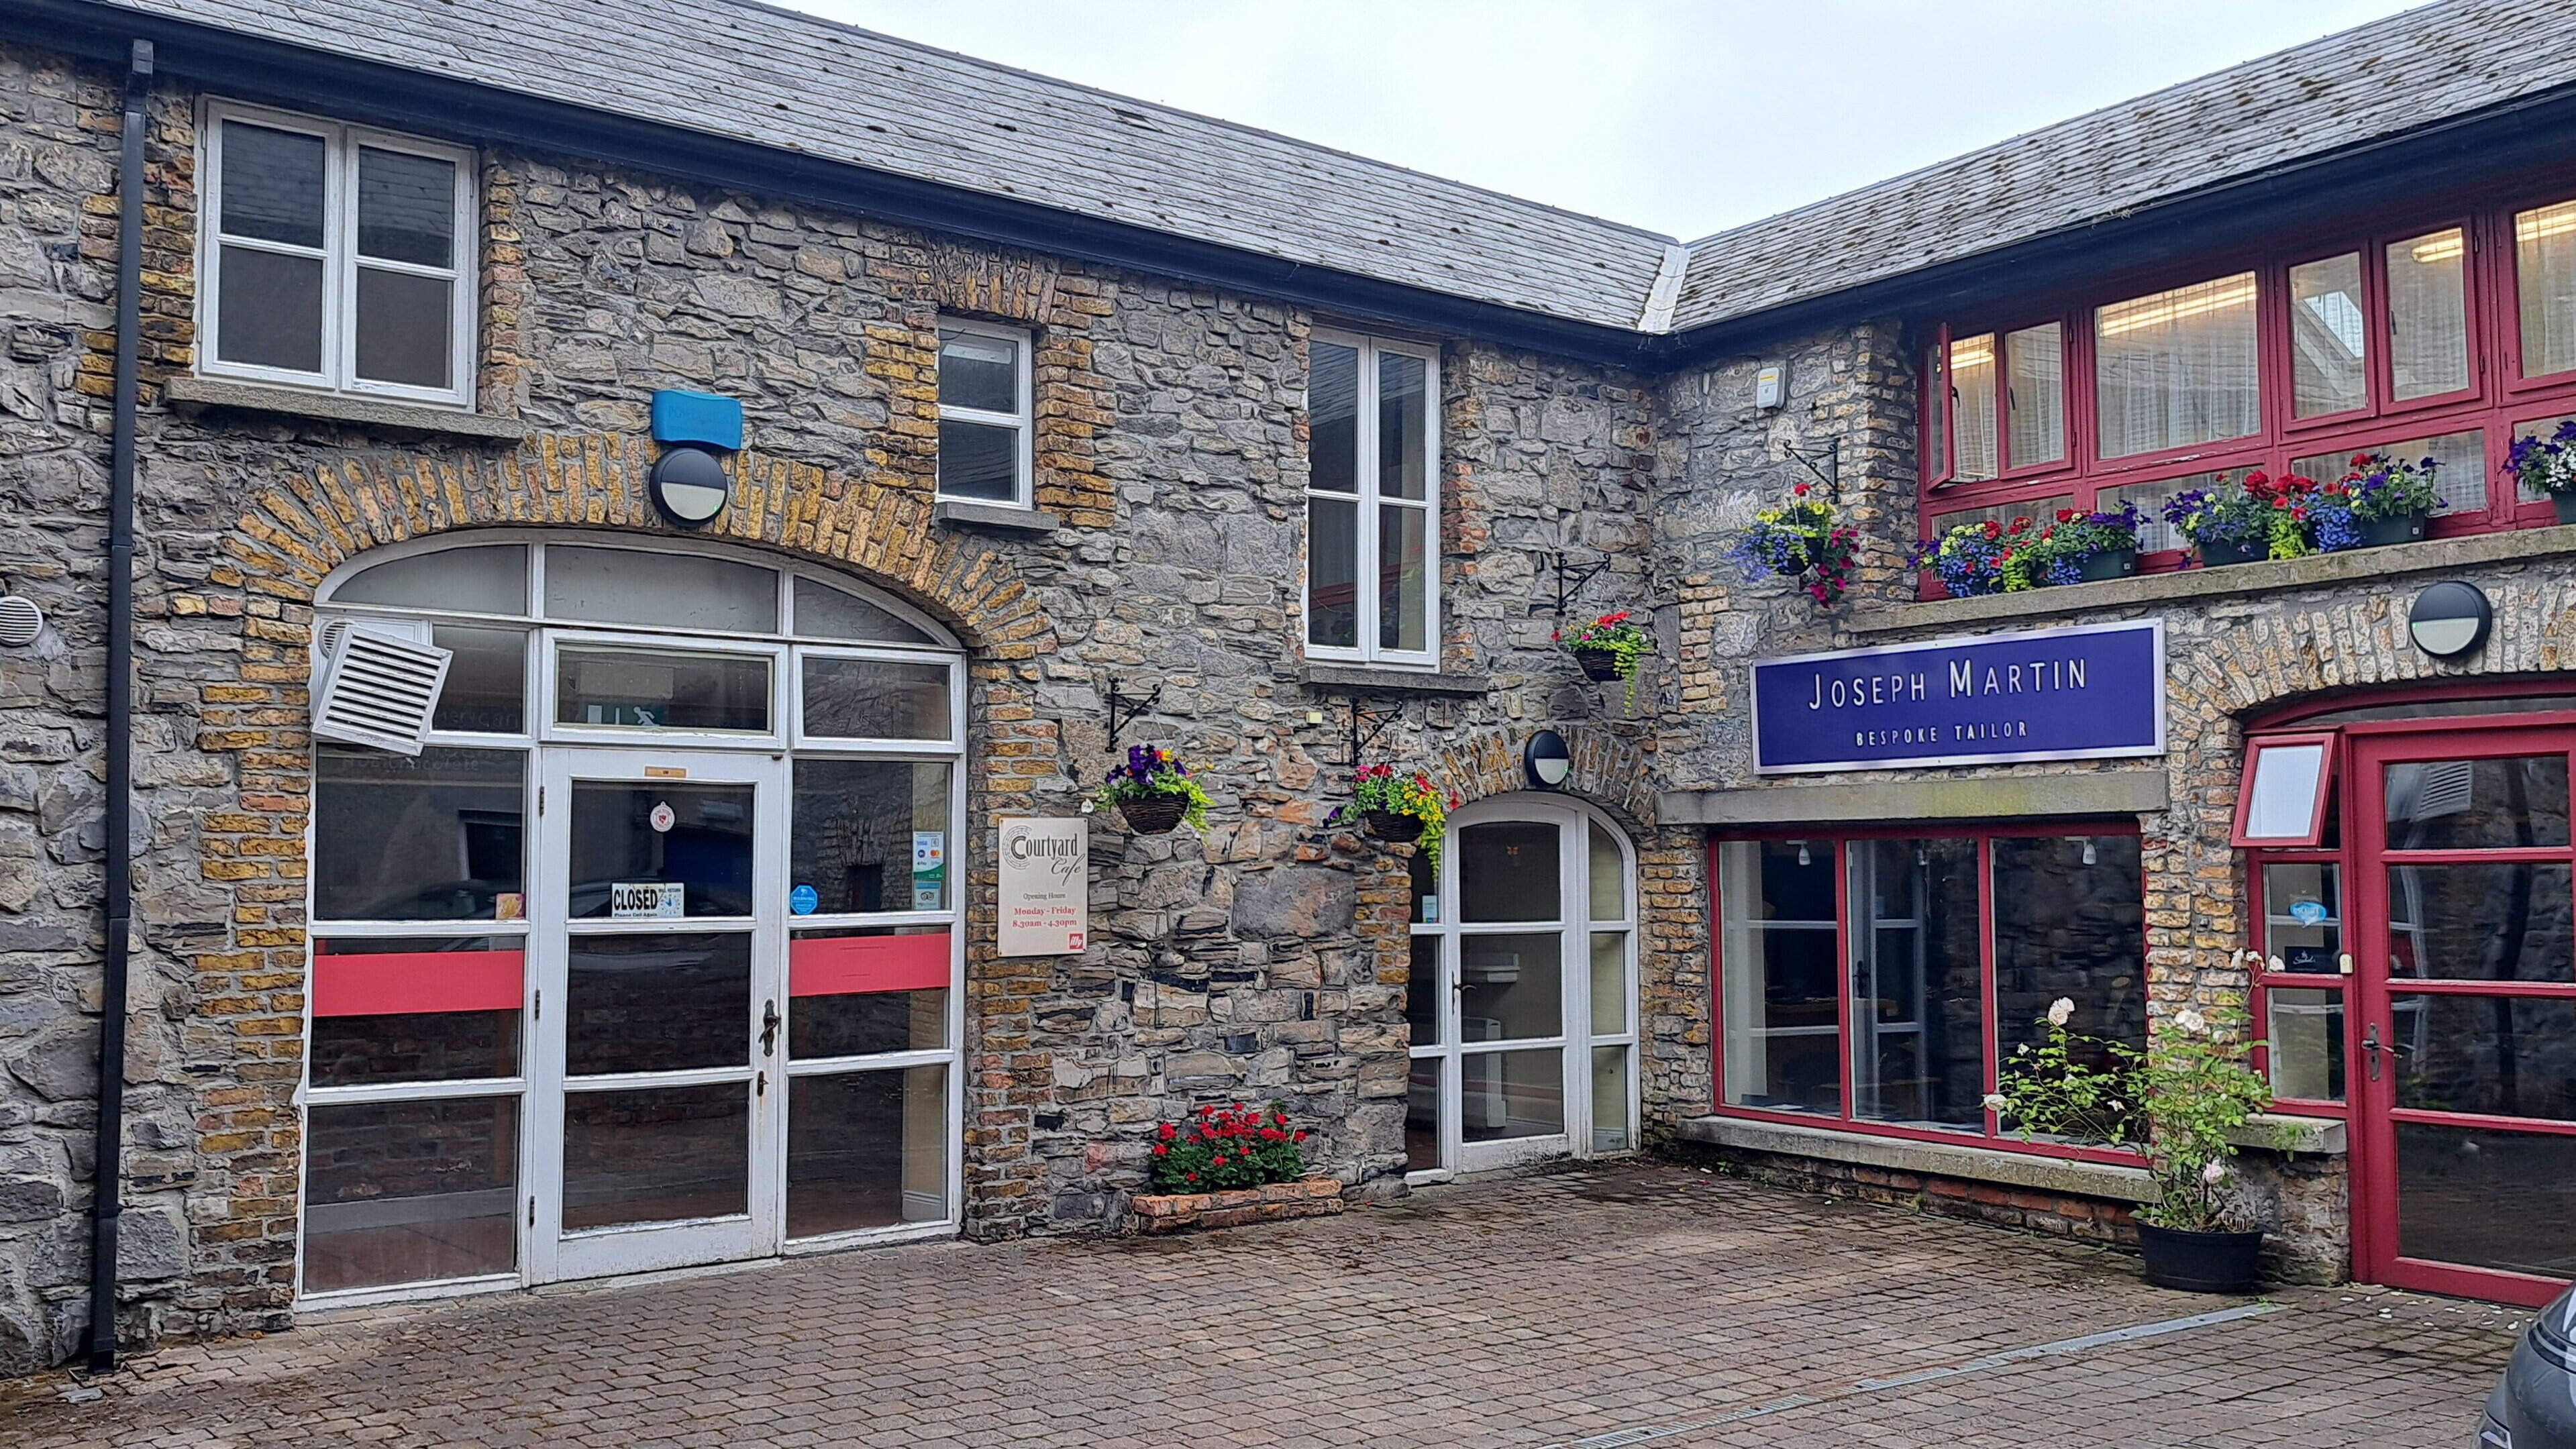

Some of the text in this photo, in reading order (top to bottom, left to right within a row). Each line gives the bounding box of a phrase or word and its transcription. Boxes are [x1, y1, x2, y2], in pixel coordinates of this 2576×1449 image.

[1808, 657, 2087, 710] JOSEPH MARTIN
[1855, 720, 2028, 747] BESPOKE TAILOR
[1010, 833, 1078, 860] Courtyard
[613, 888, 658, 910] CLOSED
[1023, 892, 1047, 901] Opening
[1015, 907, 1045, 916] Monday
[1051, 906, 1076, 915] Friday
[1013, 920, 1042, 928] 8.30am
[1047, 919, 1078, 928] 4.30pm
